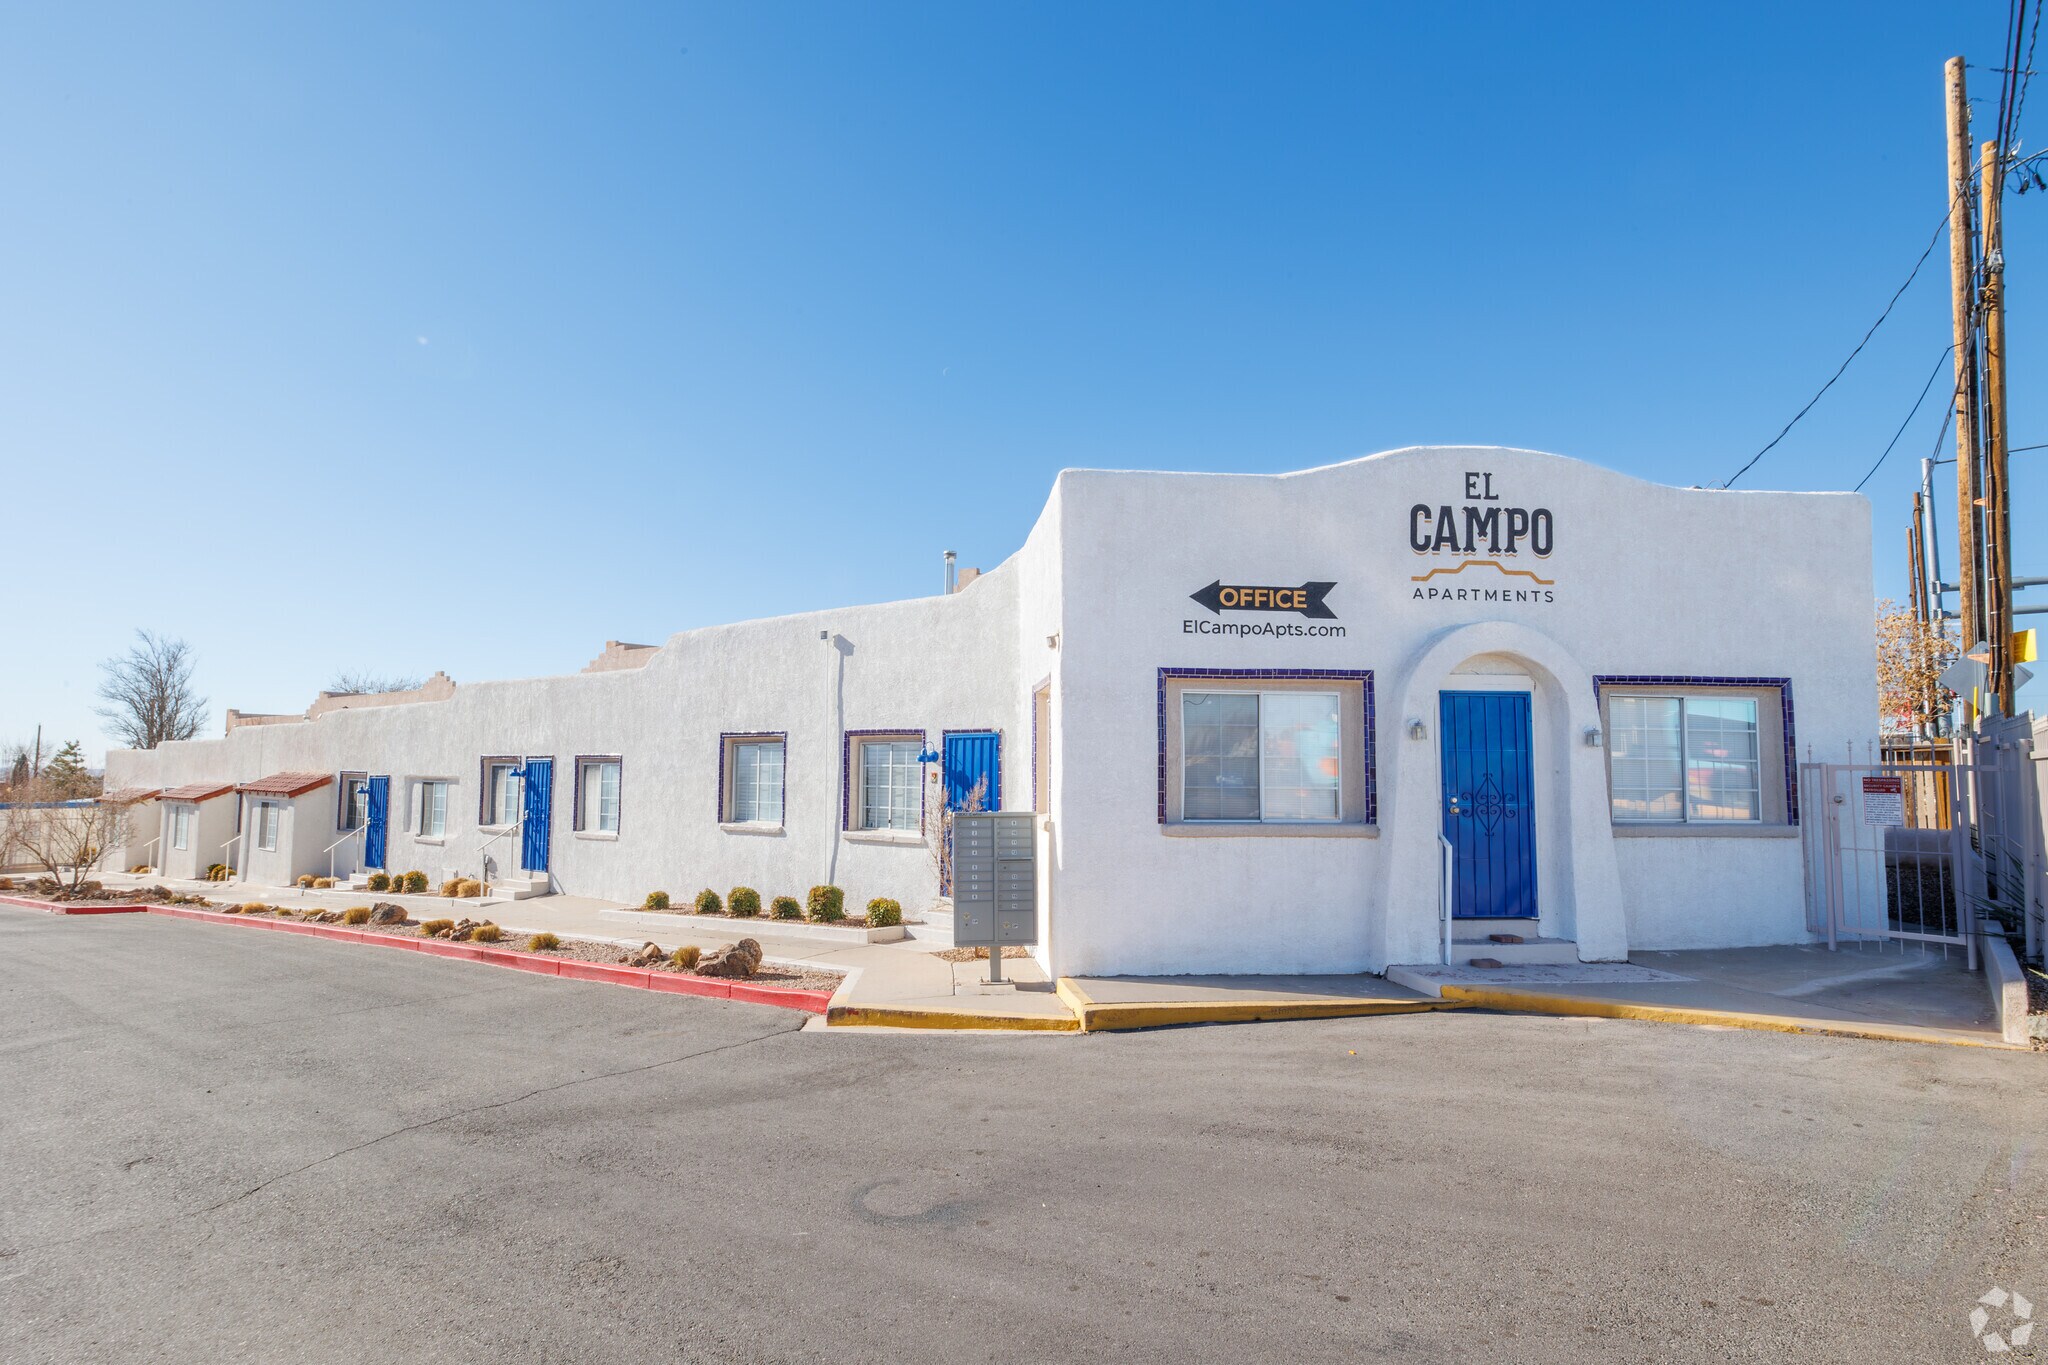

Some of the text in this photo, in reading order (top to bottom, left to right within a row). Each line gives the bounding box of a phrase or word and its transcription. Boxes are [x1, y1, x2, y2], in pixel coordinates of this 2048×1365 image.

[1465, 472, 1499, 500] EL
[1410, 504, 1554, 558] CAMPO
[1219, 588, 1308, 609] OFFICE
[1412, 587, 1554, 603] APARTMENTS
[1183, 620, 1346, 638] ElCampoApts.com
